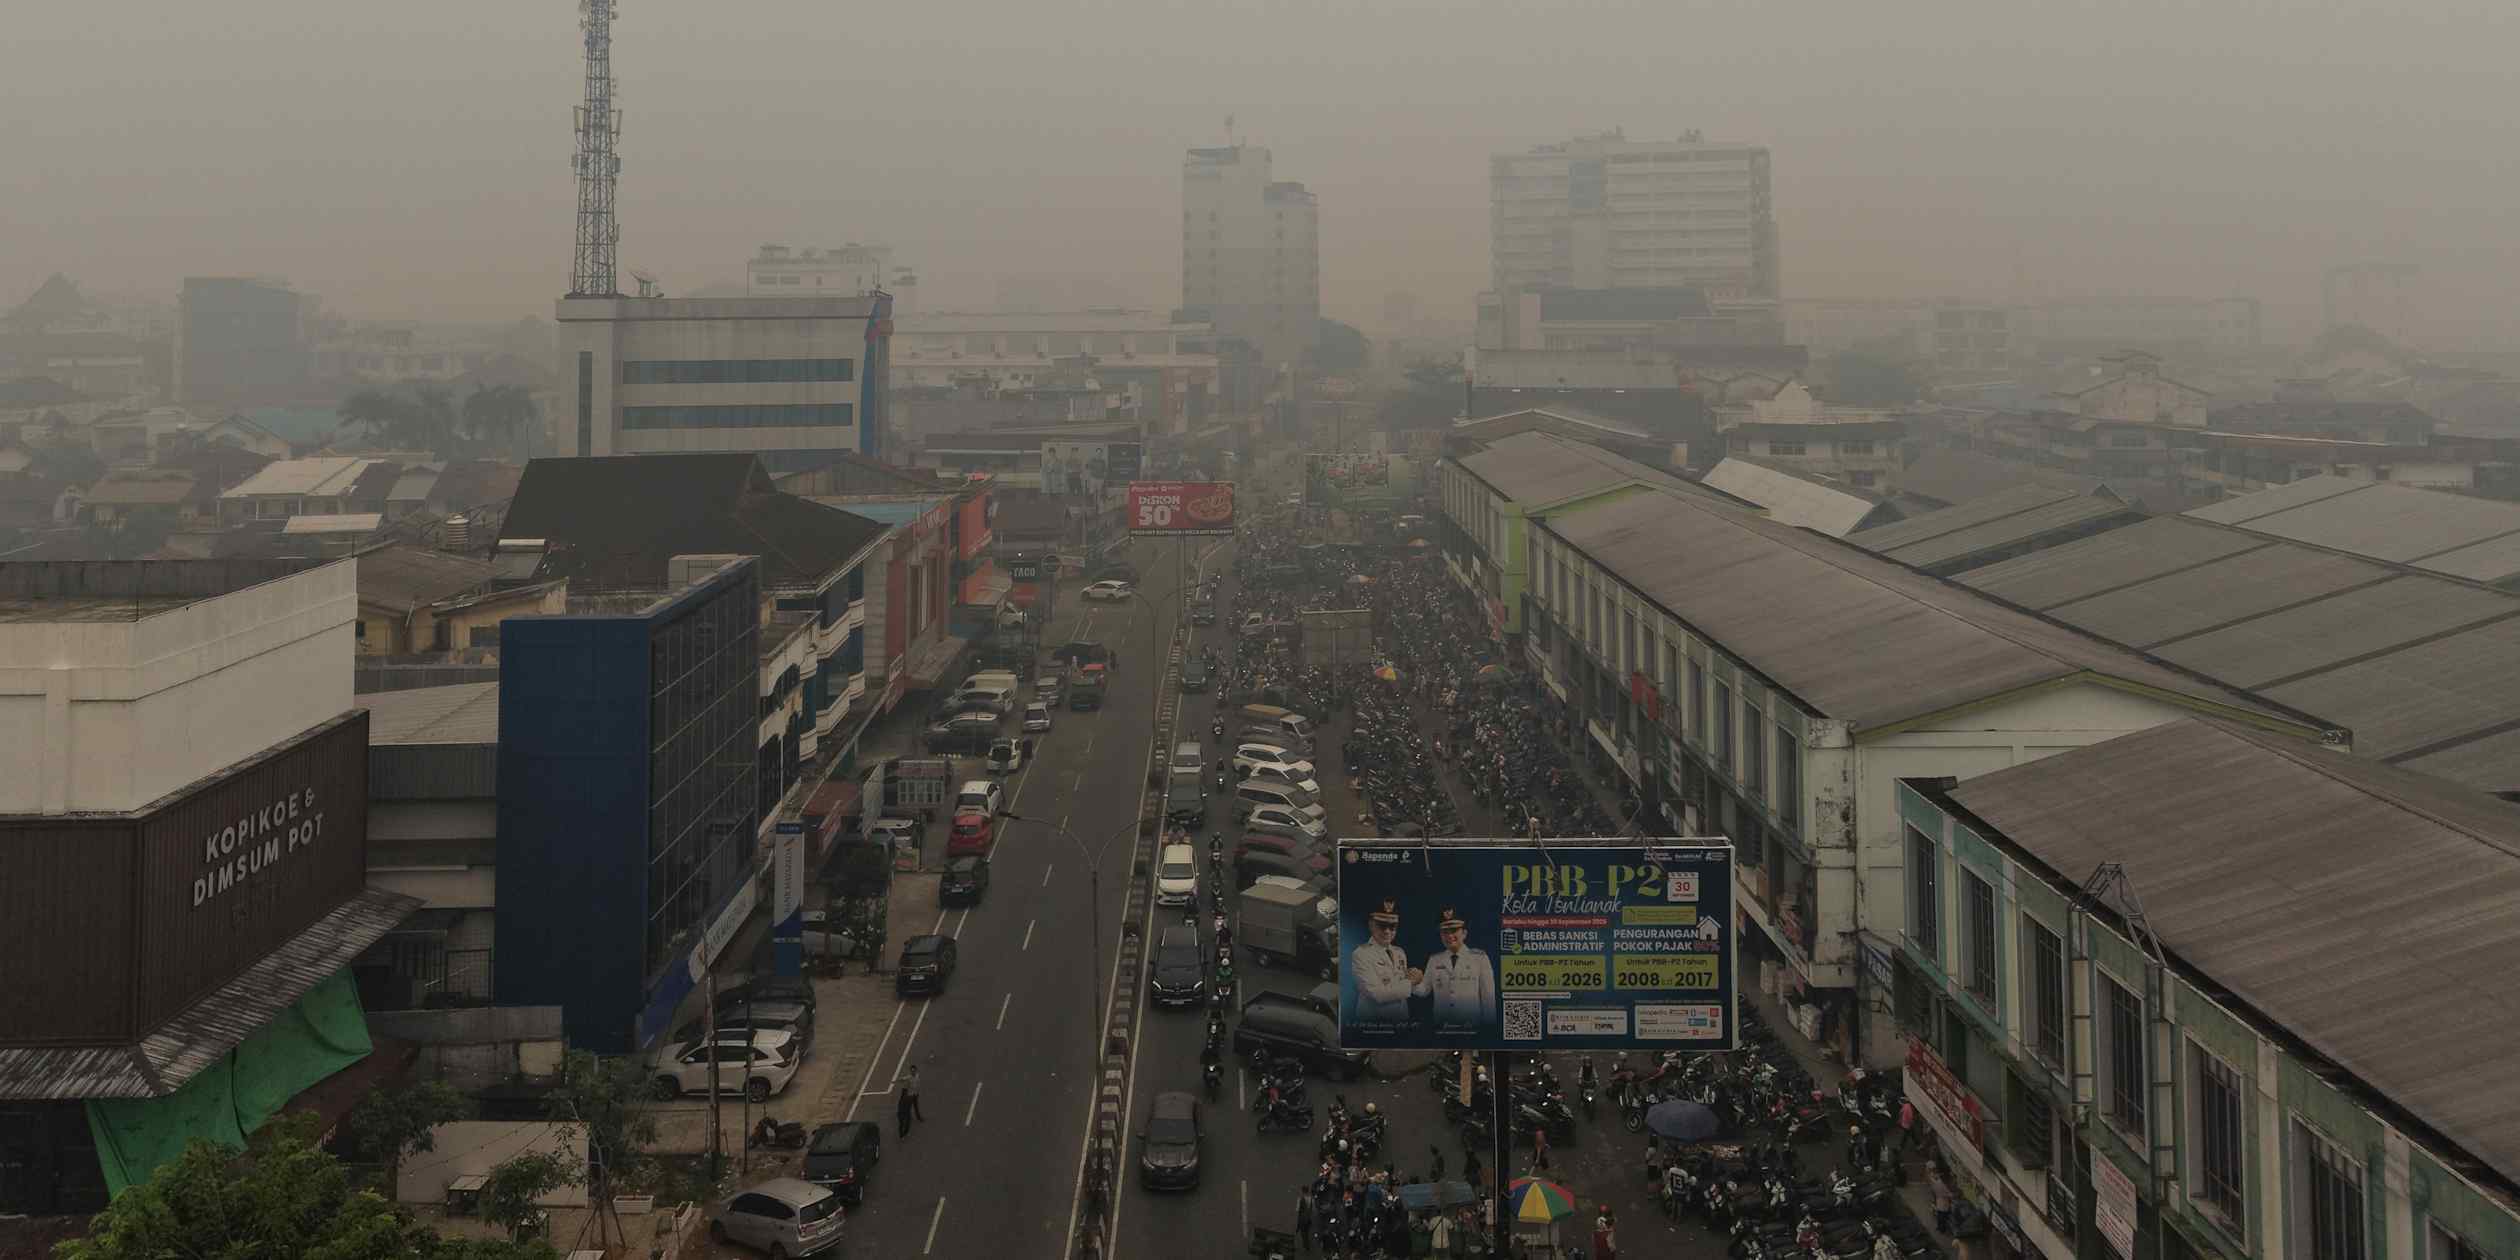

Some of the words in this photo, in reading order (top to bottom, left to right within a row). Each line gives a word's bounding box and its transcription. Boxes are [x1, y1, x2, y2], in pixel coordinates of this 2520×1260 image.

[206, 792, 300, 863] KOPIKOE
[304, 786, 316, 808] &
[193, 837, 280, 907] DIMSUM
[288, 811, 324, 853] POT
[1503, 865, 1661, 896] PBB-P2
[1675, 882, 1690, 891] 30
[1502, 889, 1537, 913] Kota
[1522, 931, 1557, 941] BEBAS
[1559, 931, 1598, 941] SANKSI
[1614, 929, 1698, 939] PENGURANGAN
[1523, 942, 1605, 951] ADMINISTRATIF
[1614, 941, 1653, 951] POKOK
[1655, 941, 1692, 951] PAJAK
[1505, 973, 1547, 986] 2008
[1562, 973, 1602, 986] 2026
[1618, 972, 1660, 986] 2008
[1675, 972, 1712, 986] 2017
